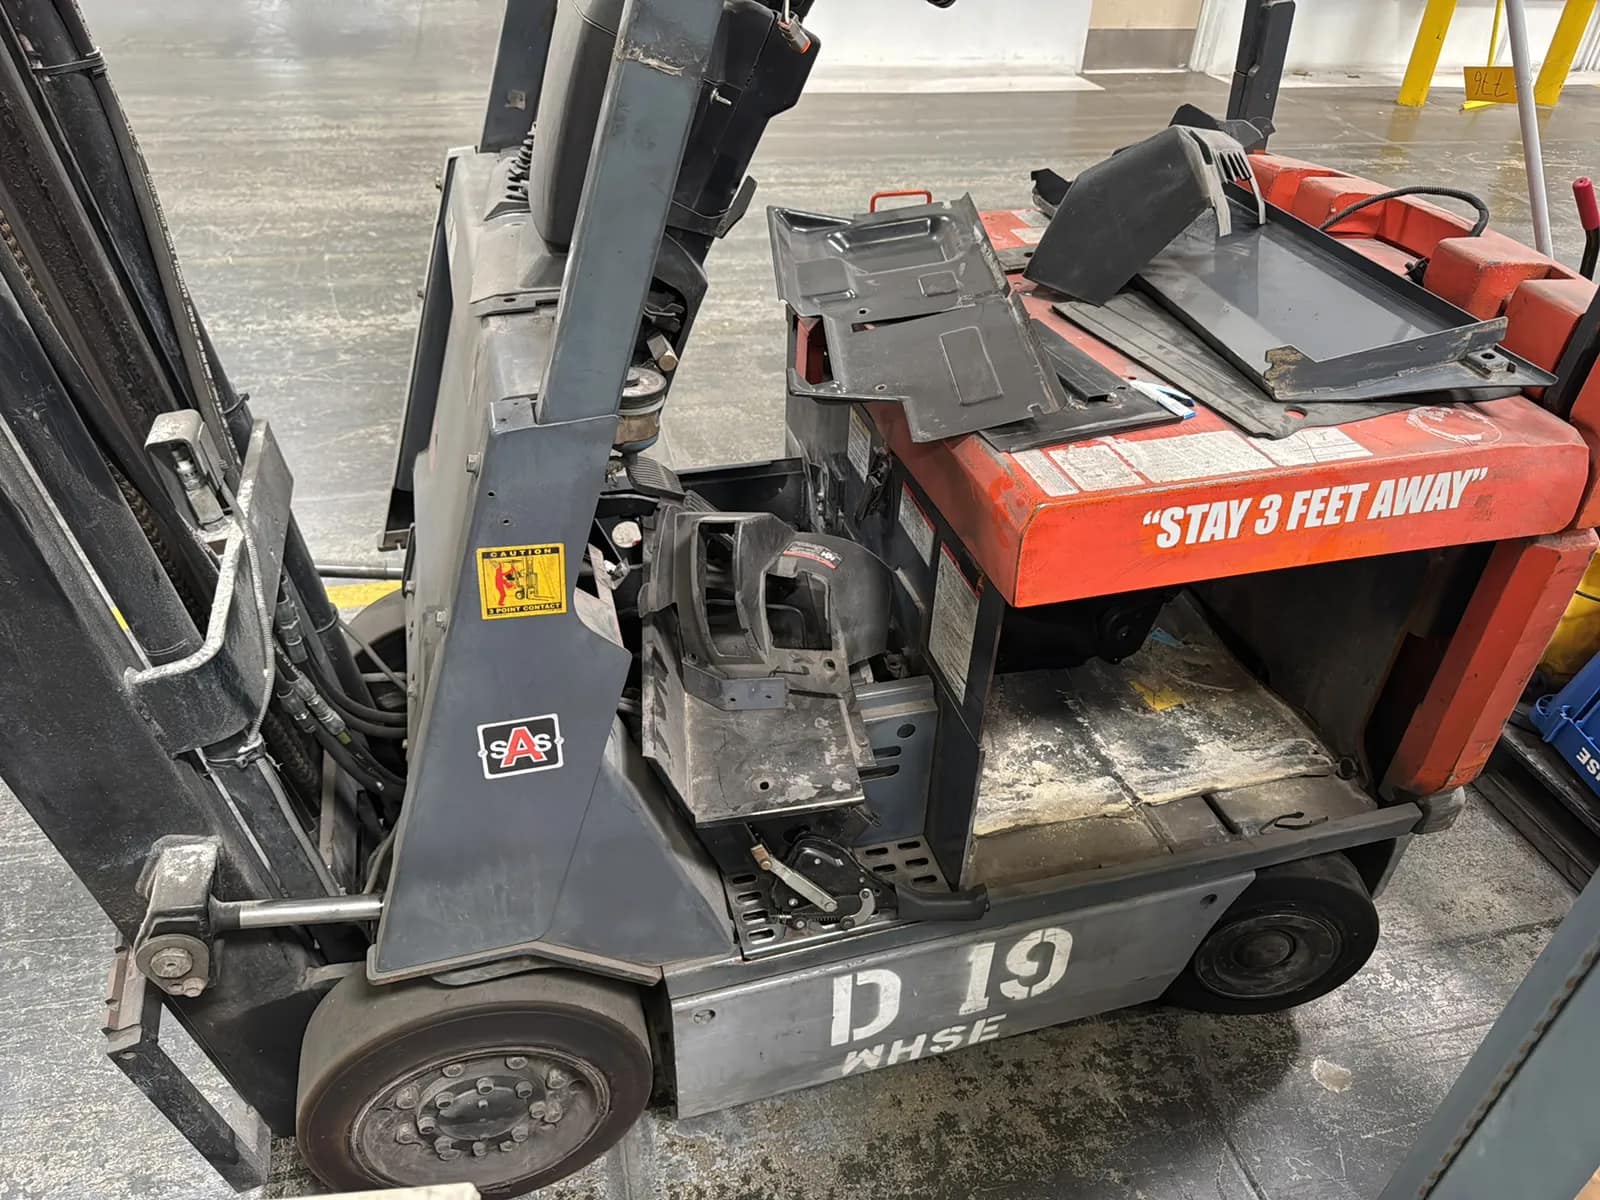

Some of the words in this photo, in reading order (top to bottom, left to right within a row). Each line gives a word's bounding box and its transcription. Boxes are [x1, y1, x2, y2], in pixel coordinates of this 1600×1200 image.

[1254, 493, 1283, 535] 3
[1286, 482, 1370, 531] FEET
[490, 548, 552, 558] CAUTION
[522, 603, 560, 611] CONTACT
[830, 968, 902, 1047] D
[958, 927, 1074, 1016] 19
[841, 1013, 1008, 1077] WHSE
